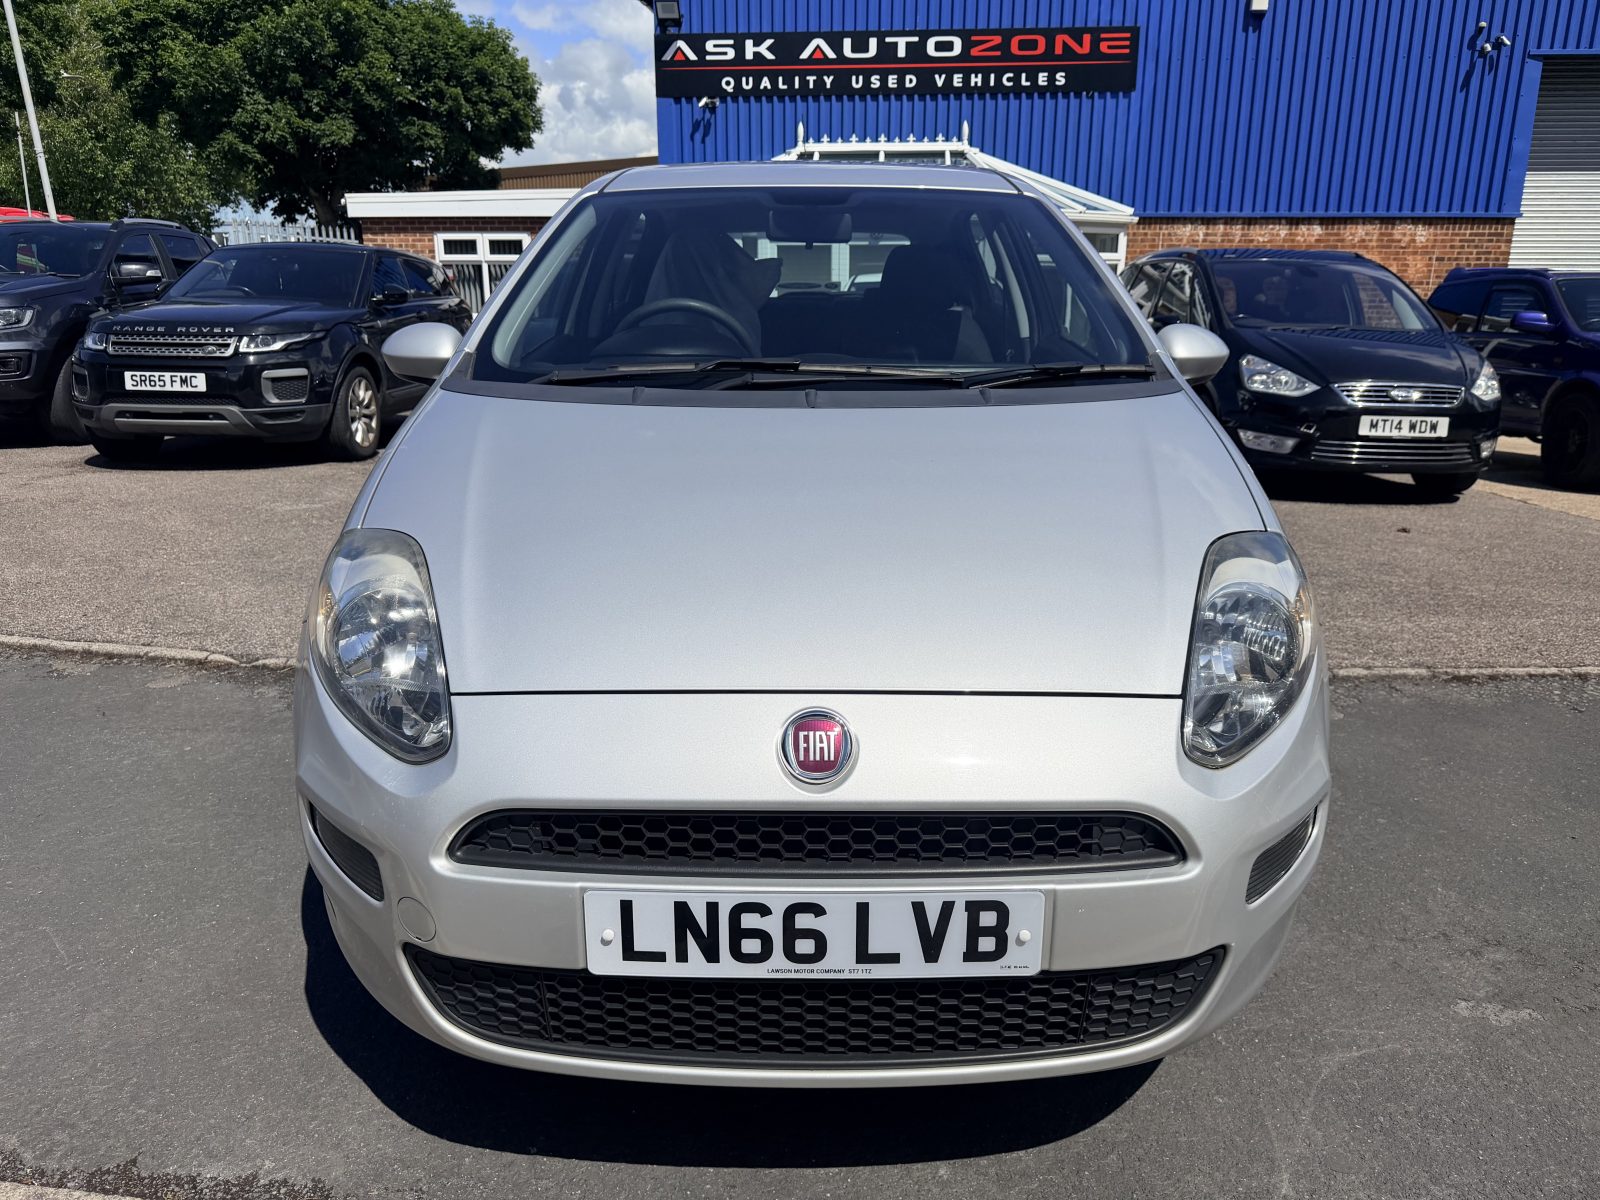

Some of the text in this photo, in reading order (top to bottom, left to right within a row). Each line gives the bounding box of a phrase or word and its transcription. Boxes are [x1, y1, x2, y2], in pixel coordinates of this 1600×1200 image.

[660, 32, 1132, 61] ASK AUTOZONE
[721, 71, 1067, 92] QUALITY USED VEHICLES
[130, 374, 198, 388] SR65 FMC
[1369, 418, 1439, 434] MT14 WDW
[798, 730, 838, 761] FIAT
[619, 899, 1011, 965] LN66 LVB
